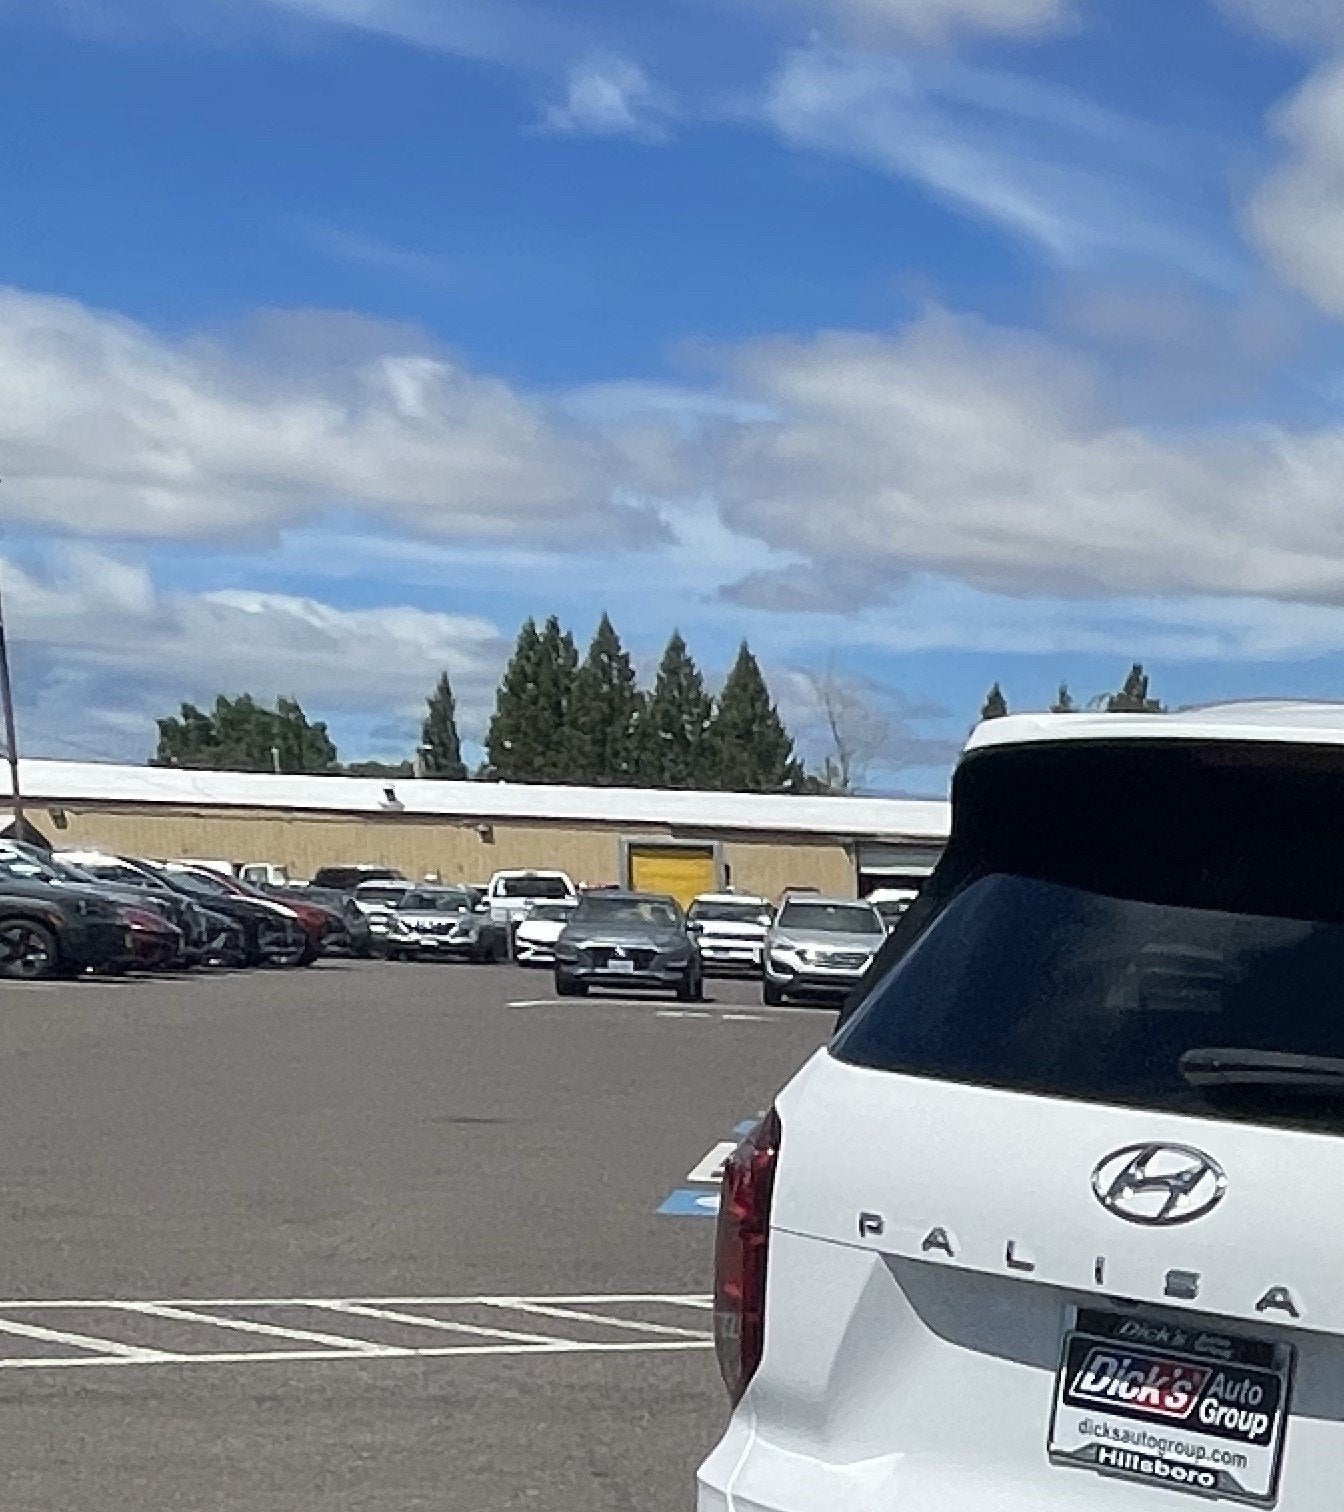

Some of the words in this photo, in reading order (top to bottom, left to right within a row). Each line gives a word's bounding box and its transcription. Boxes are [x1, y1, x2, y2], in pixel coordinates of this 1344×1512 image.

[1080, 1354, 1192, 1409] Dick's
[1209, 1373, 1263, 1404] Auto
[1199, 1398, 1268, 1438] Group
[1078, 1418, 1248, 1468] dicksautogroup.com
[1098, 1447, 1214, 1486] Hillsboro
